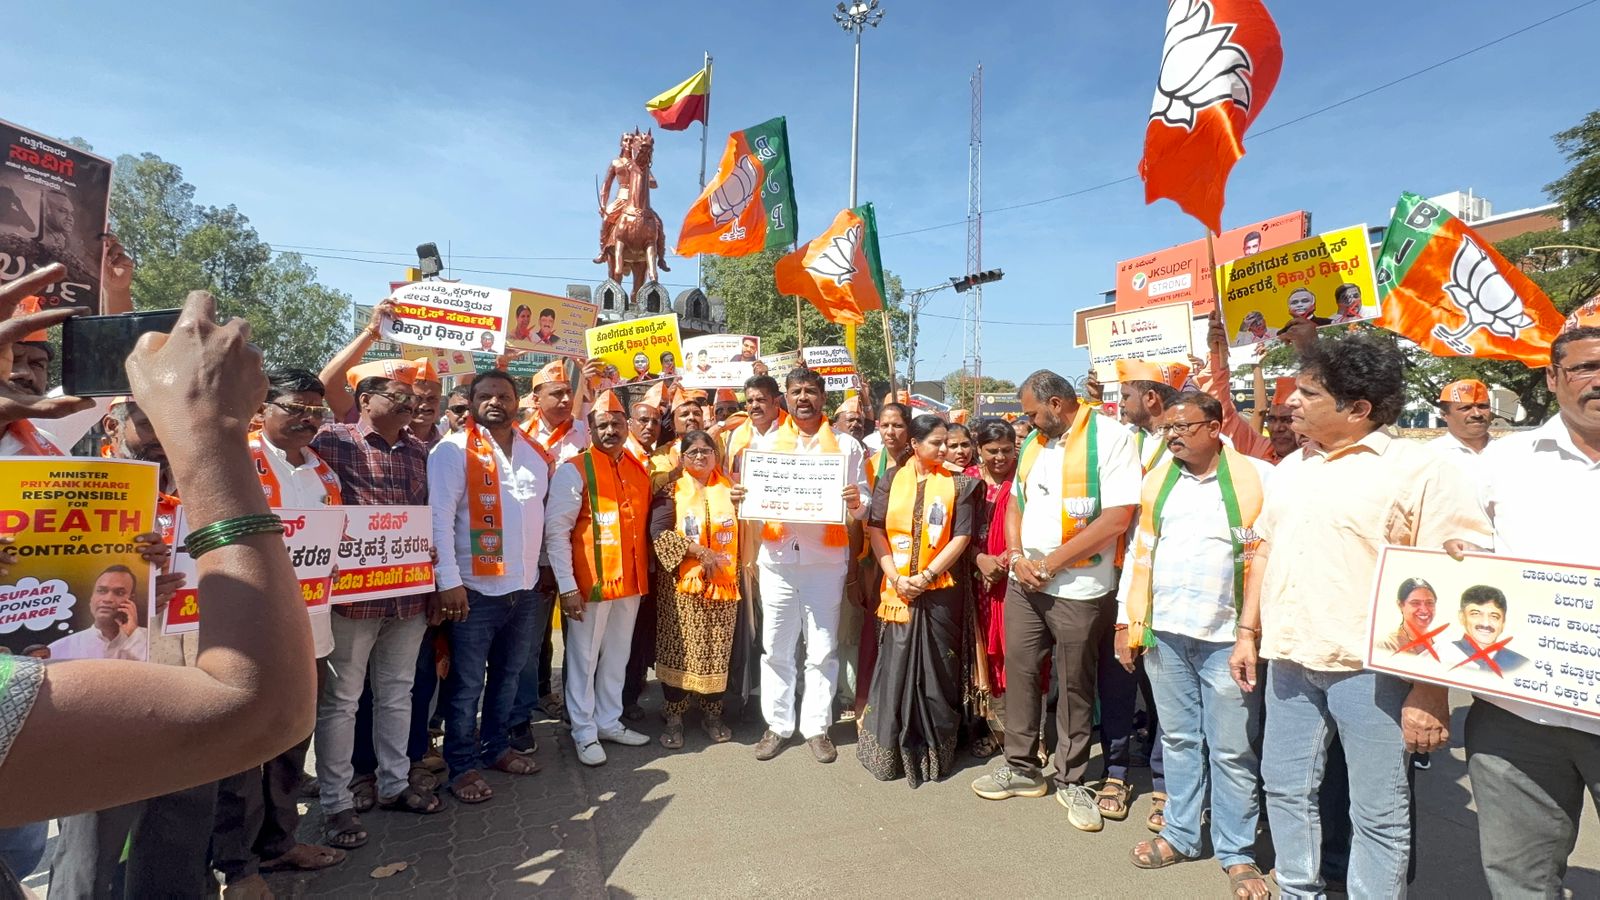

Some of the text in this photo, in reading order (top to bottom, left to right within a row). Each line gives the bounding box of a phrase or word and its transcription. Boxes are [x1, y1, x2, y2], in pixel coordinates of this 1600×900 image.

[9, 144, 74, 177] ಸಾವಿಗೆ
[1229, 238, 1348, 282] ಕೊಲೆಗಡುಕ ಕಾಂಗ್ರೆಸ್
[1152, 276, 1188, 293] STRONG
[1227, 255, 1360, 302] ಸರ್ಕಾರಕ್ಕೆ ಧಿಕ್ಕಾರ ಧಿಕ್ಕಾರ
[433, 296, 493, 312] ಹಿಂಡುತ್ತಿರುವ
[1147, 291, 1192, 305] CONCRETE SPECIAL
[447, 312, 497, 330] ಸರ್ಕಾರಕ್ಕೆ
[635, 321, 667, 335] ಕಾಂಗ್ರೆಸ್
[1111, 320, 1119, 336] A
[392, 319, 474, 346] ಧಿಕ್ಕಾರ ಧಿಕ್ಕಾರ
[49, 471, 109, 480] MINISTER
[20, 480, 130, 490] PRIYANK KHARGE
[22, 490, 128, 501] RESPONSIBLE
[0, 508, 141, 534] DEATH
[368, 511, 408, 531] ಸಚಿನ್
[338, 535, 429, 565] ಆತ್ಮಹತ್ಯೆ ಪ್ರಕರಣ
[365, 567, 403, 588] ತನಿಖೆಗೆ
[404, 566, 431, 583] ವಹಿಸಿ
[1523, 570, 1587, 586] ಬಾಣಂತಿಯರ
[0, 585, 55, 602] SUPARI
[1554, 593, 1594, 610] ಶಿಶುಗಳ
[0, 595, 61, 613] PONSOR
[1528, 614, 1560, 628] ಸಾವಿನ
[1514, 677, 1548, 693] ಅವರಿಗೆ
